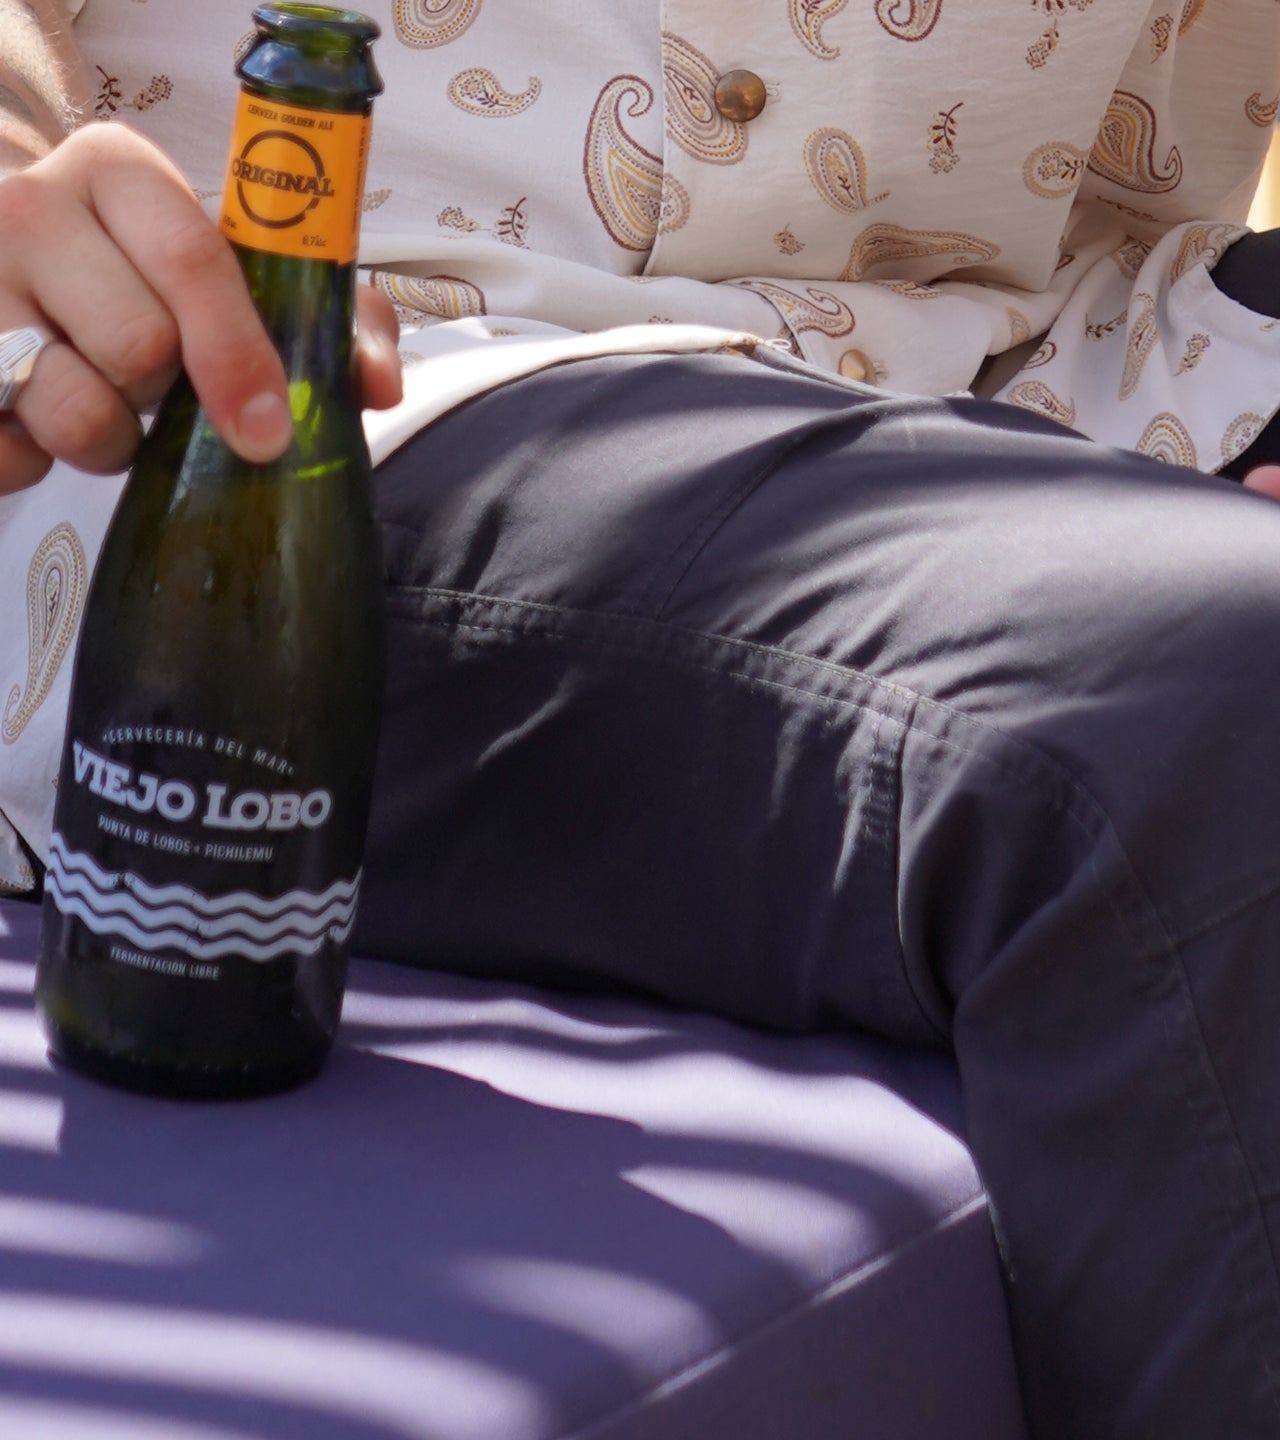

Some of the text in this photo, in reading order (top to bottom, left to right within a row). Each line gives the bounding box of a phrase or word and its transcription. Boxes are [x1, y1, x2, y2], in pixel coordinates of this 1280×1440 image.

[232, 158, 335, 197] ORIGINAL
[215, 737, 245, 758] DEL
[253, 749, 288, 774] MAR
[73, 740, 332, 831] VIEJO LOBO
[98, 814, 274, 862] PUNTA DE LOBOS PICHILEMU
[189, 964, 220, 979] LIBRE
